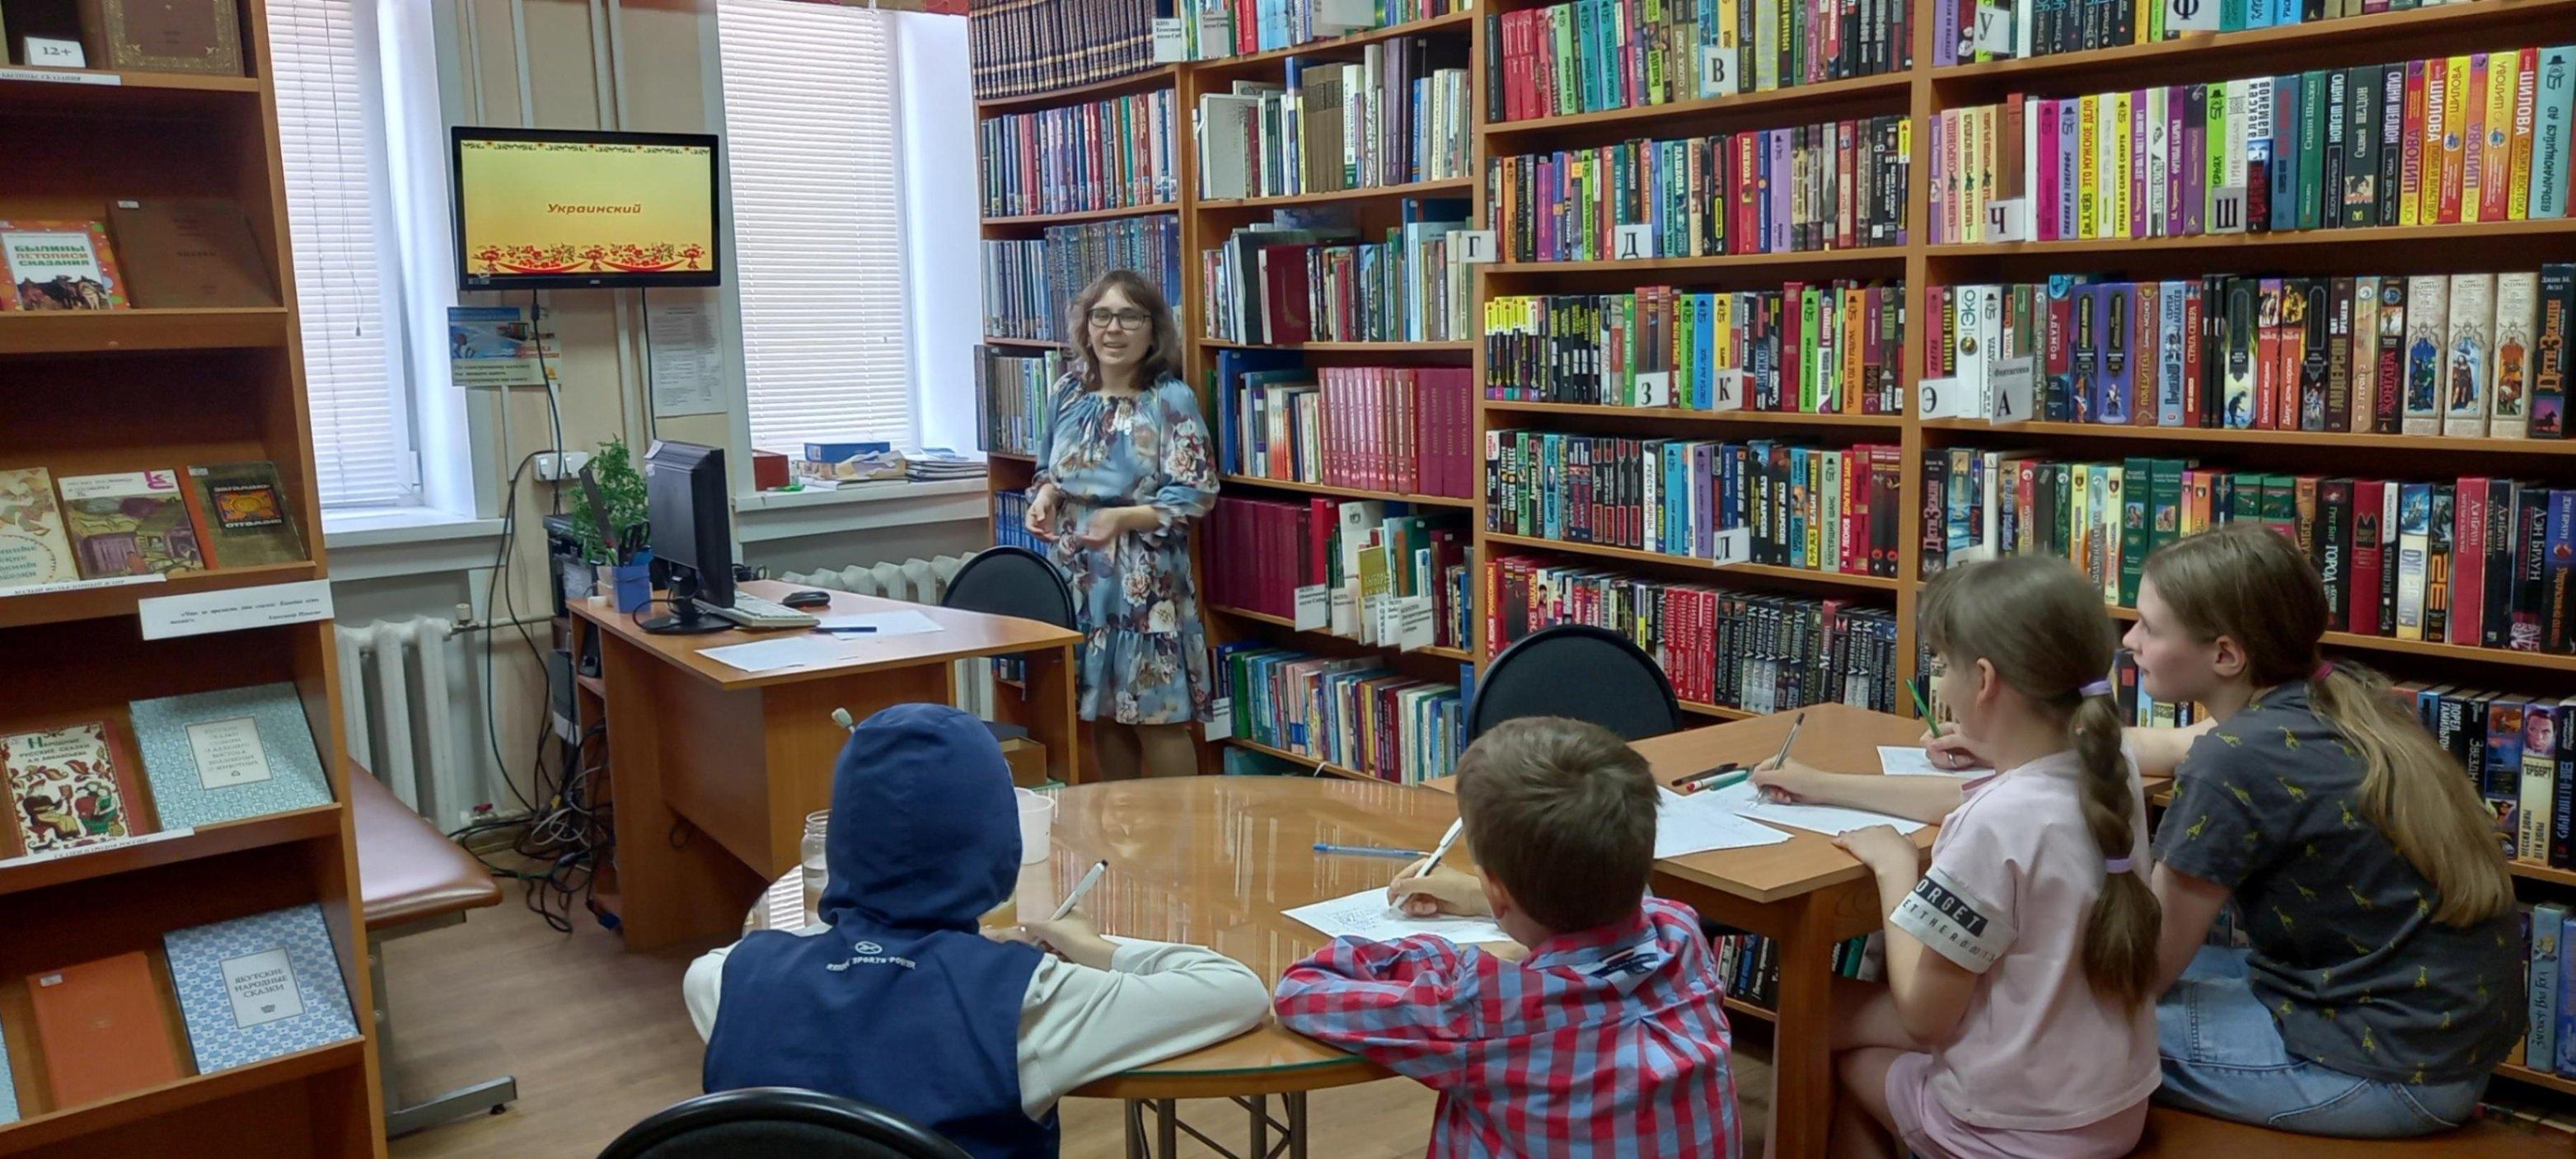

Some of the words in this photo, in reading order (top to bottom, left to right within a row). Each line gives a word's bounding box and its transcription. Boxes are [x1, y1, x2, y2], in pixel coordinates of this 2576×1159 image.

[42, 47, 72, 56] 12+
[1712, 58, 1725, 82] В
[2330, 74, 2344, 102] СИДНИ
[2386, 72, 2402, 101] СИДНИ
[2449, 65, 2461, 113] ШИЛОВА
[2493, 61, 2508, 109] ШИЛОВА
[2083, 100, 2094, 124] ДЕЛО
[2249, 83, 2257, 138] алексей
[2258, 82, 2269, 136] шаманов
[2427, 80, 2444, 142] ШИЛОВА
[2516, 71, 2534, 135] ШИЛОВА
[2329, 105, 2343, 143] ШЕЛДОН
[2385, 103, 2400, 143] ШЕЛДОН
[2083, 126, 2092, 169] МУЖСКОЕ
[2403, 129, 2420, 193] ШИЛОВА
[2465, 122, 2482, 188] ШИЛОВА
[2083, 171, 2091, 187] ЭТО
[548, 204, 641, 214] Украинский
[2119, 191, 2125, 202] ДО
[1989, 206, 2006, 234] Ч
[2216, 198, 2238, 229] Ш
[1468, 236, 1481, 257] Г
[1622, 232, 1639, 260] Д
[1719, 377, 1731, 401] К
[1923, 387, 1937, 413] Э
[1997, 390, 2012, 416] А
[1842, 518, 1850, 547] ЛЕОНОВ
[2532, 507, 2546, 537] ДЭН
[2560, 514, 2570, 539] БРАУН
[1716, 536, 1731, 561] Л
[2530, 540, 2545, 581] БРАУН
[2322, 545, 2338, 582] ГОРОД
[2449, 702, 2462, 731] ЛОРЕЛ
[1916, 879, 1981, 930] ORGET
[235, 968, 283, 983] ЯКУТСКИЕ
[235, 974, 288, 992] НАРОДНЫЕ
[243, 983, 285, 998] СКАЗКИ
